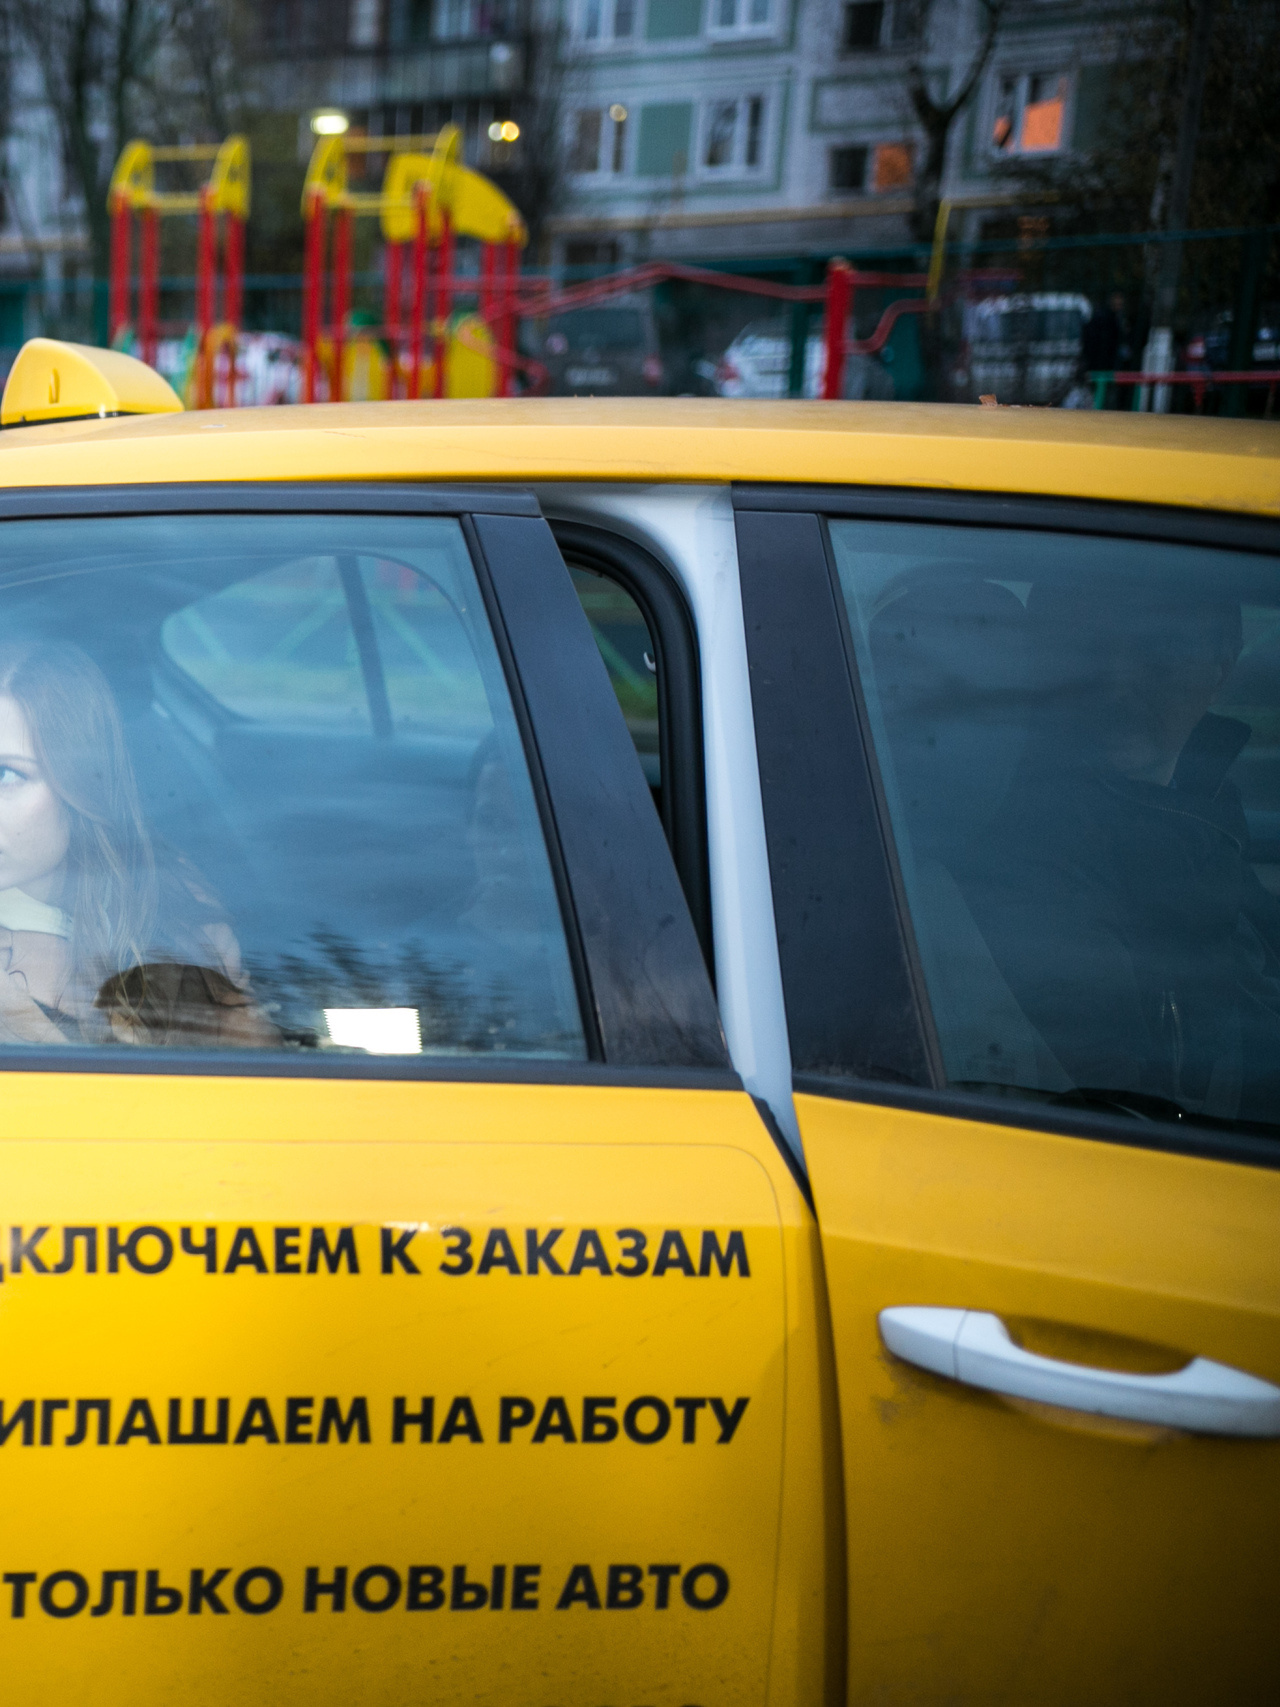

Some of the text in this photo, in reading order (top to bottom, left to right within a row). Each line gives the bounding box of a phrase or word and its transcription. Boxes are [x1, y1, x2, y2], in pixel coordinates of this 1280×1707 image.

[381, 1228, 421, 1275] К
[438, 1228, 752, 1279] ЗАКАЗАМ
[390, 1396, 485, 1445] НА
[497, 1395, 751, 1446] РАБОТУ
[2, 1562, 731, 1619] ТОЛЬКО НОВЫЕ АВТО
